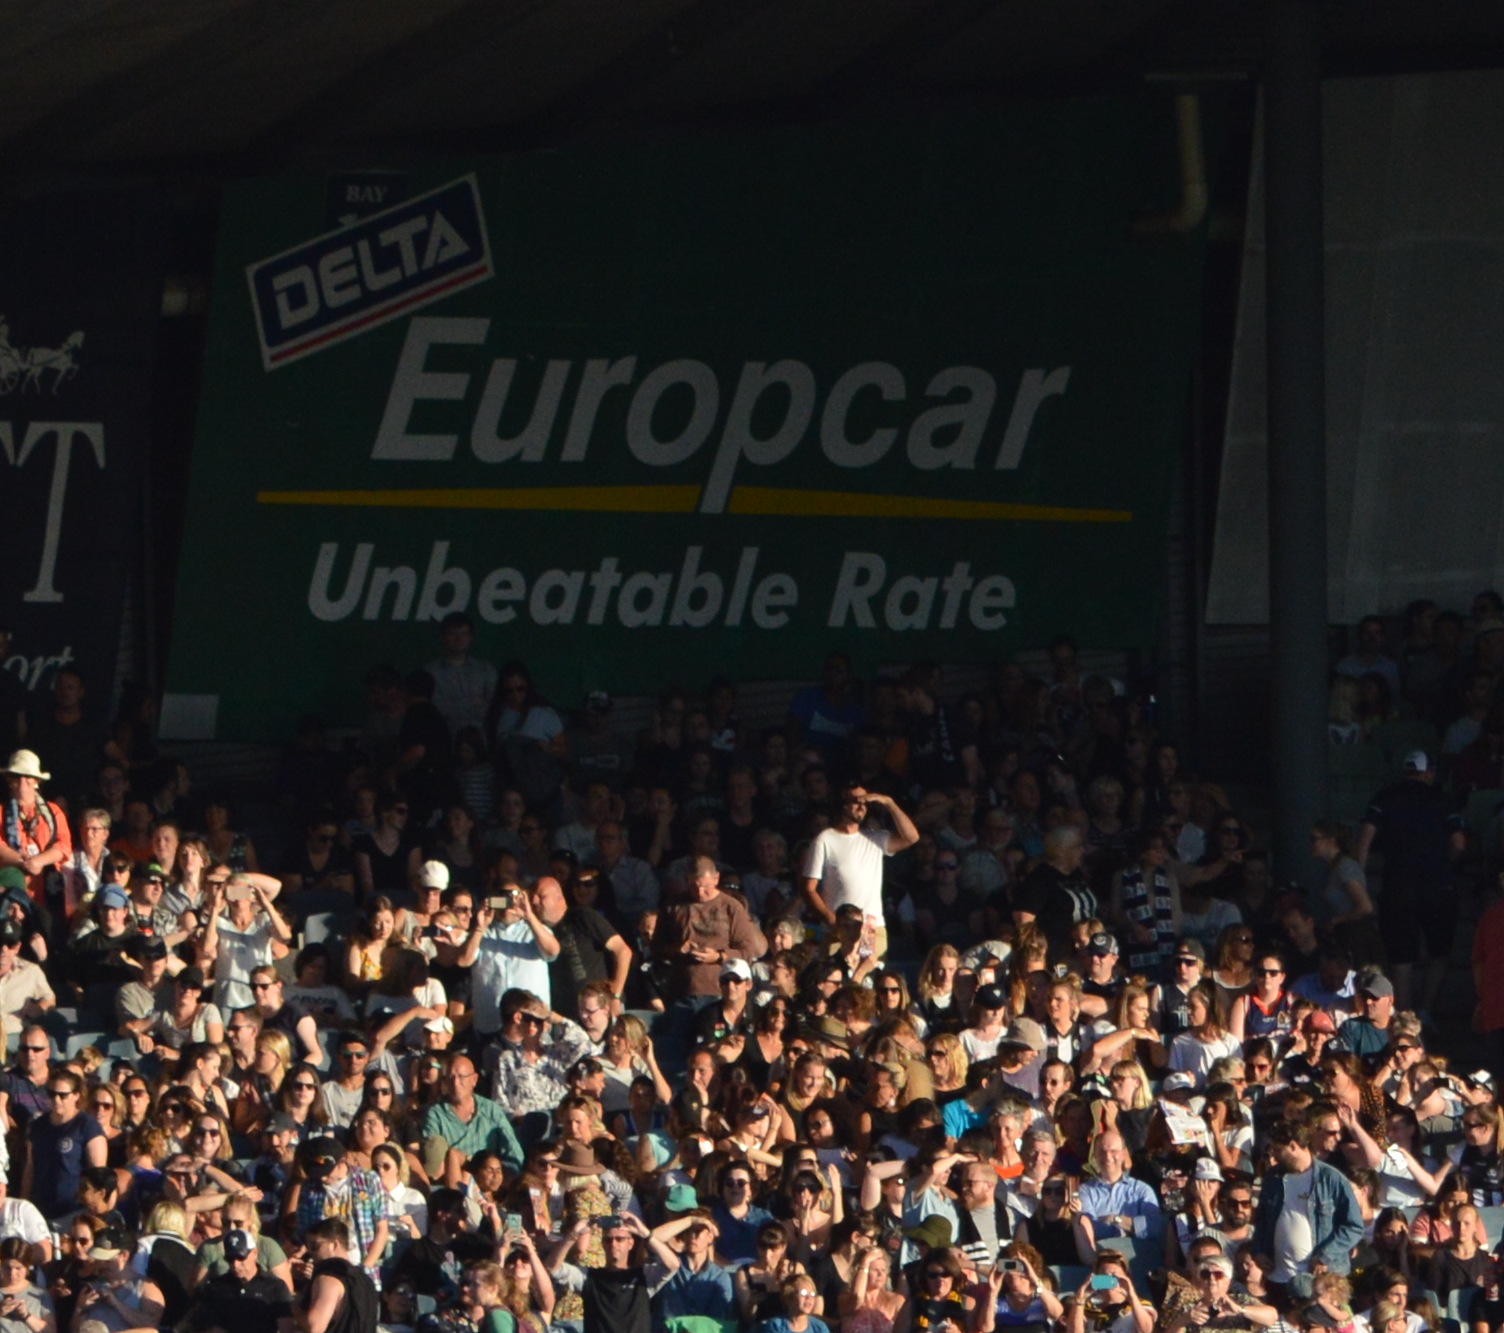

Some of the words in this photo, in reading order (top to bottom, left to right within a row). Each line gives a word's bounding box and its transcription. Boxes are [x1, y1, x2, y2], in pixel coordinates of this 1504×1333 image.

[346, 185, 388, 203] BAY
[272, 209, 471, 331] DELTA
[369, 316, 1071, 514] Europcar
[307, 540, 799, 630] Unbeatable
[828, 550, 1017, 632] Rate
